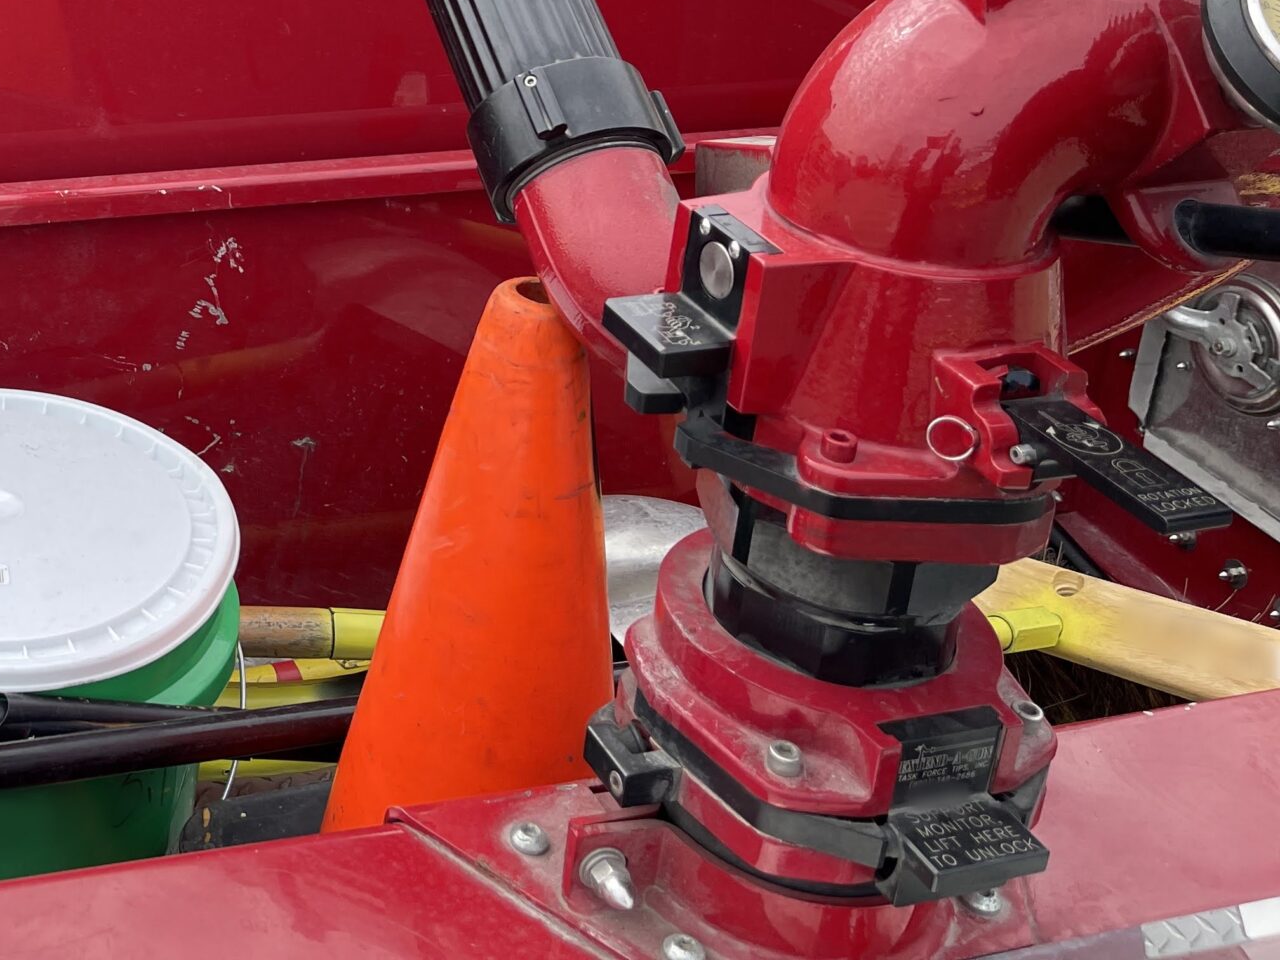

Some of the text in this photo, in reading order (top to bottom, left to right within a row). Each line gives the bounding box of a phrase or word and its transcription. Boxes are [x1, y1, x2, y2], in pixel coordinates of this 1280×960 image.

[1137, 486, 1203, 501] ROTATION
[1151, 496, 1216, 512] LOCKED
[922, 767, 948, 778] FORCE
[916, 814, 1004, 837] MONITOR,
[924, 825, 1020, 853] LIFT HERE
[930, 837, 1040, 867] TO UNLOCK
